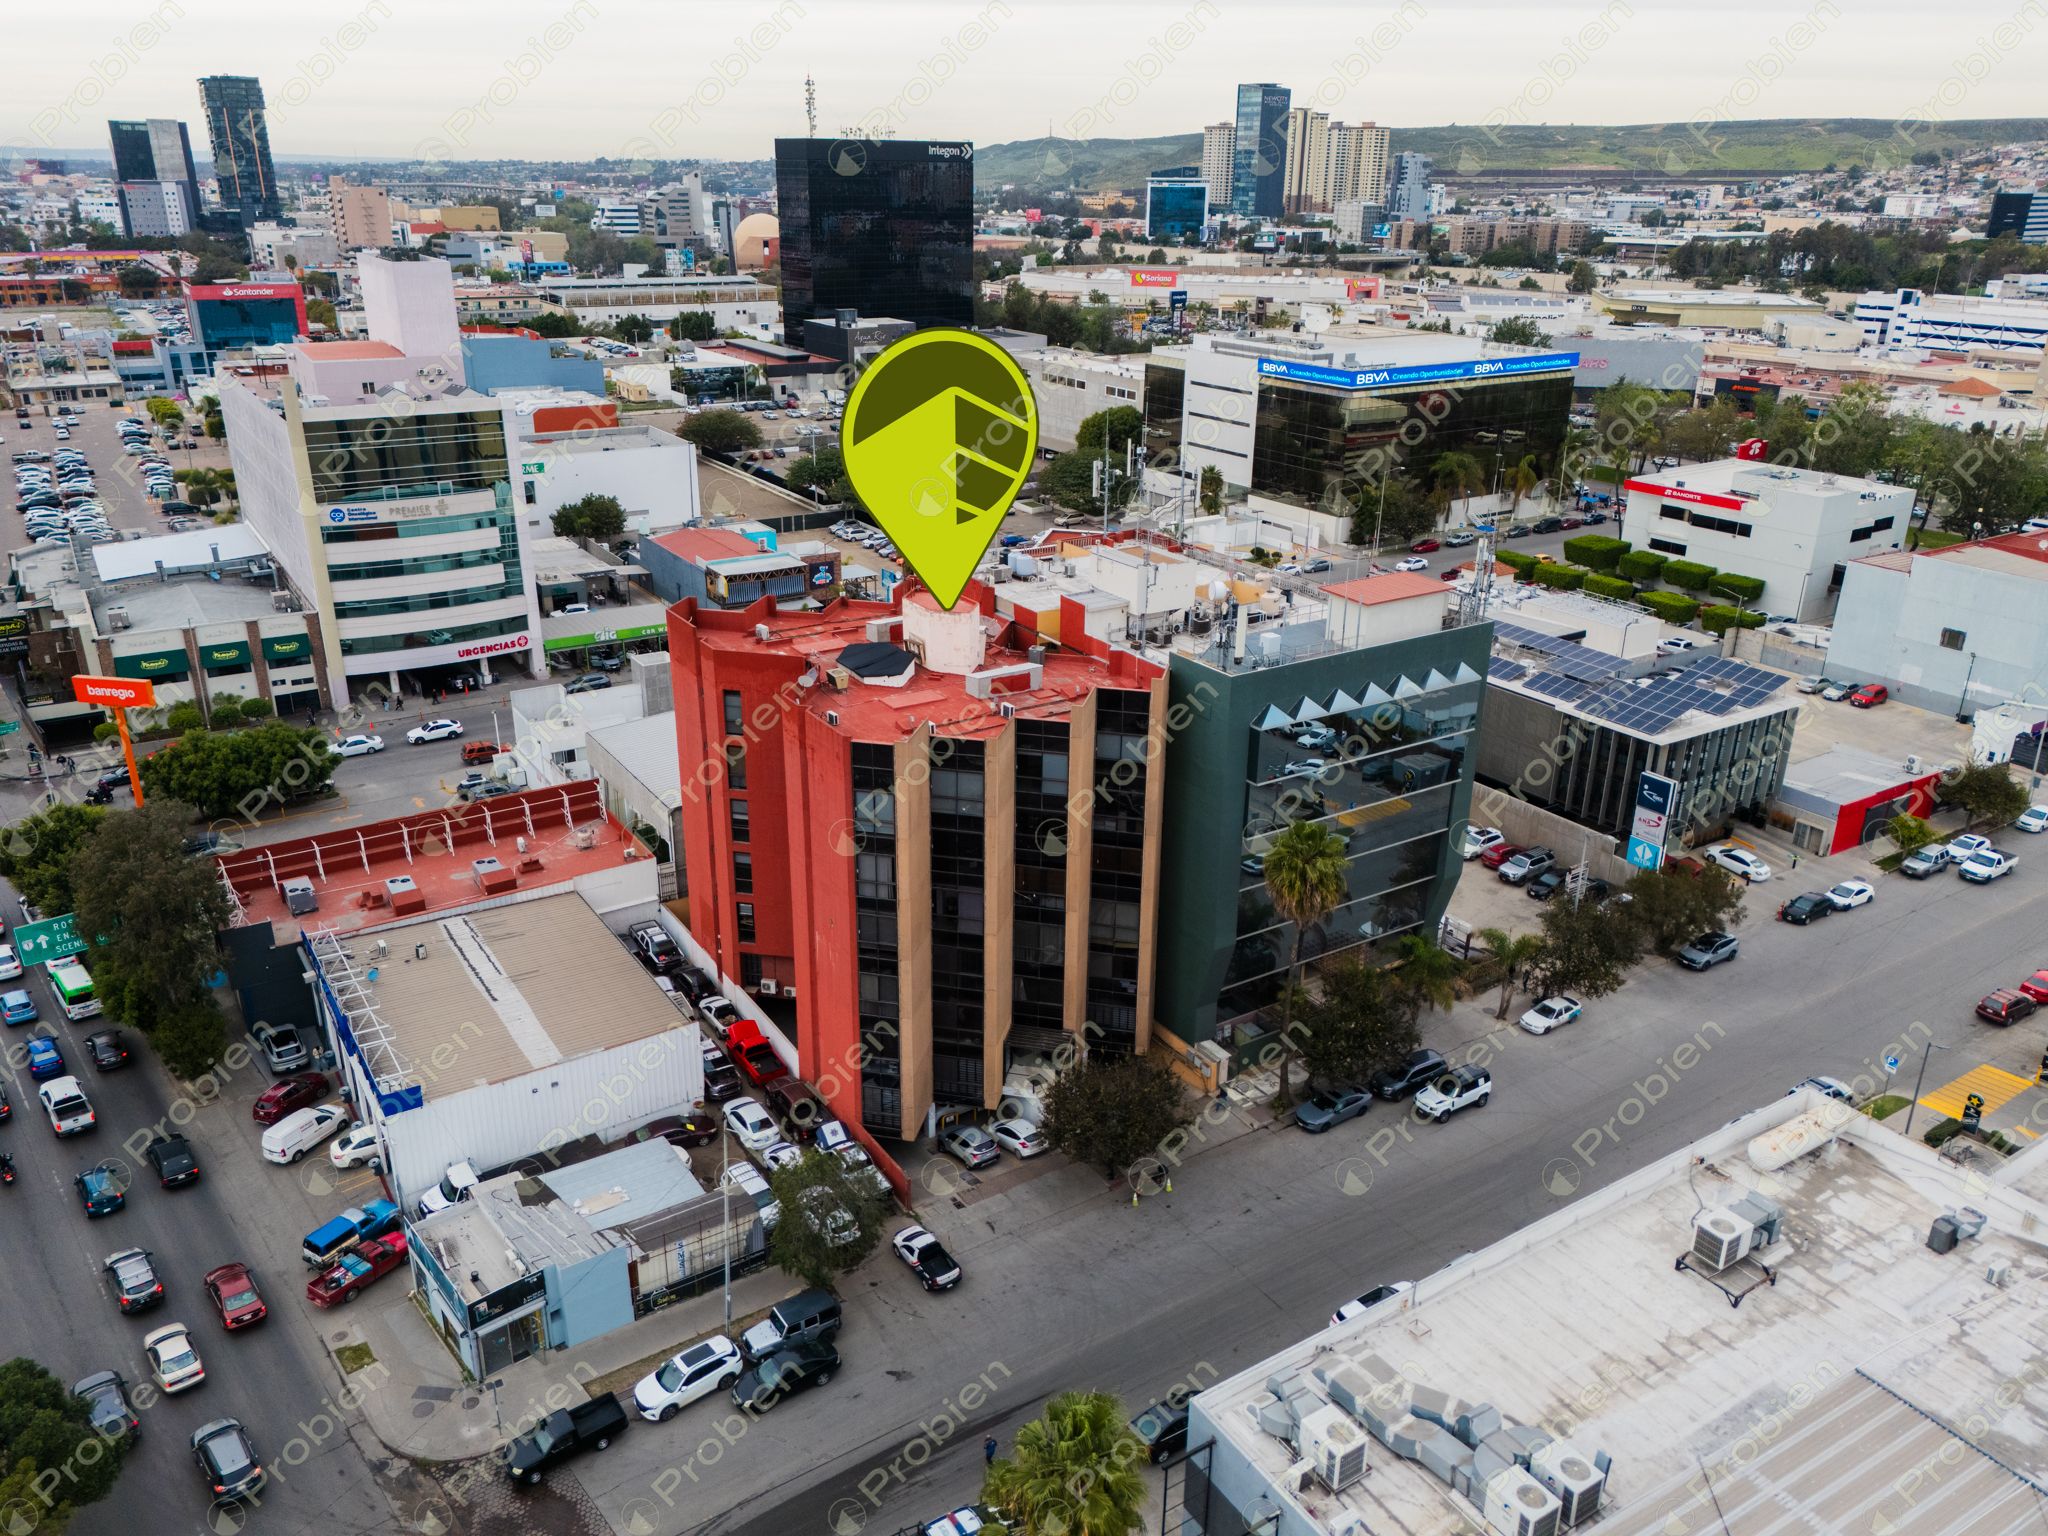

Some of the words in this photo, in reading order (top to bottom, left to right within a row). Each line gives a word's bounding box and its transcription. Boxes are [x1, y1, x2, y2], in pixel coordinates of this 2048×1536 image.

[928, 145, 960, 158] Integon
[1145, 274, 1173, 282] Soriana
[234, 288, 274, 296] Santander
[1262, 362, 1288, 374] BBVA
[1290, 369, 1311, 378] Creando
[1311, 371, 1351, 384] Oportunidades
[1474, 362, 1504, 374] BBVA
[1506, 361, 1529, 370] Creando
[1530, 358, 1571, 369] Oportunidades
[1356, 371, 1390, 385] BBVA
[1392, 371, 1417, 380] Creando
[1419, 367, 1464, 379] Oportunidades
[1672, 489, 1702, 501] BANORTE
[389, 504, 431, 516] PREMIER
[458, 640, 516, 658] URGENCIAS
[86, 684, 135, 700] banregio
